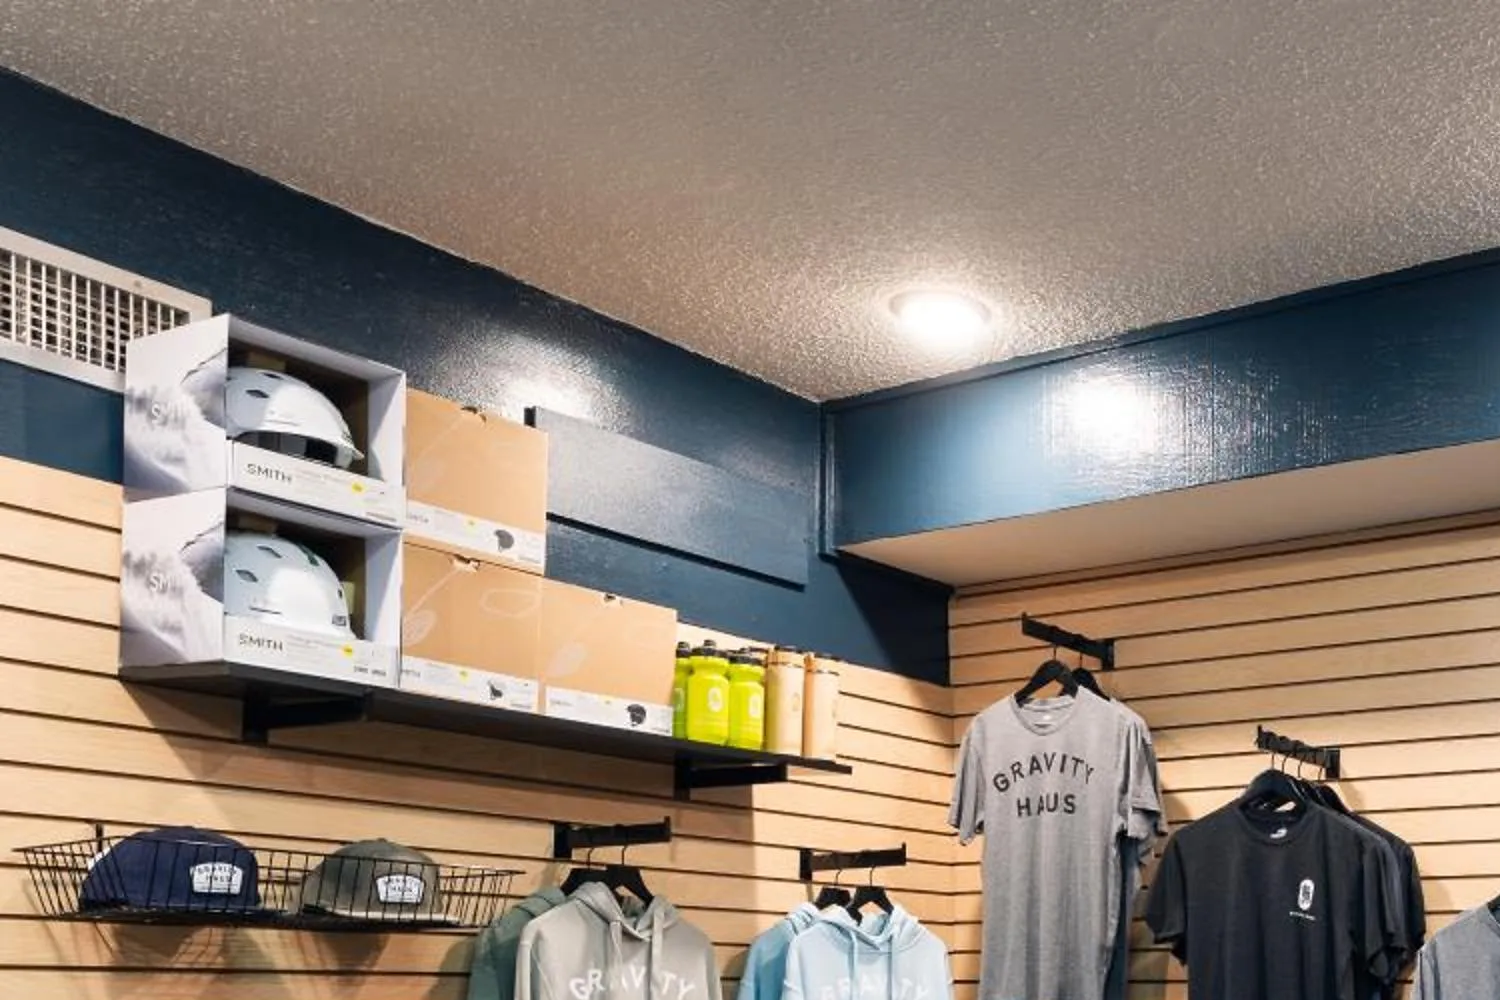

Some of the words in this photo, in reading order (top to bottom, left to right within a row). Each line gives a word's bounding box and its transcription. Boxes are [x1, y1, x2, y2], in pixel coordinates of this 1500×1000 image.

[245, 463, 293, 484] SMITH
[238, 632, 284, 652] SMITH
[992, 751, 1095, 792] GRAVITY
[1016, 792, 1076, 817] HAUS
